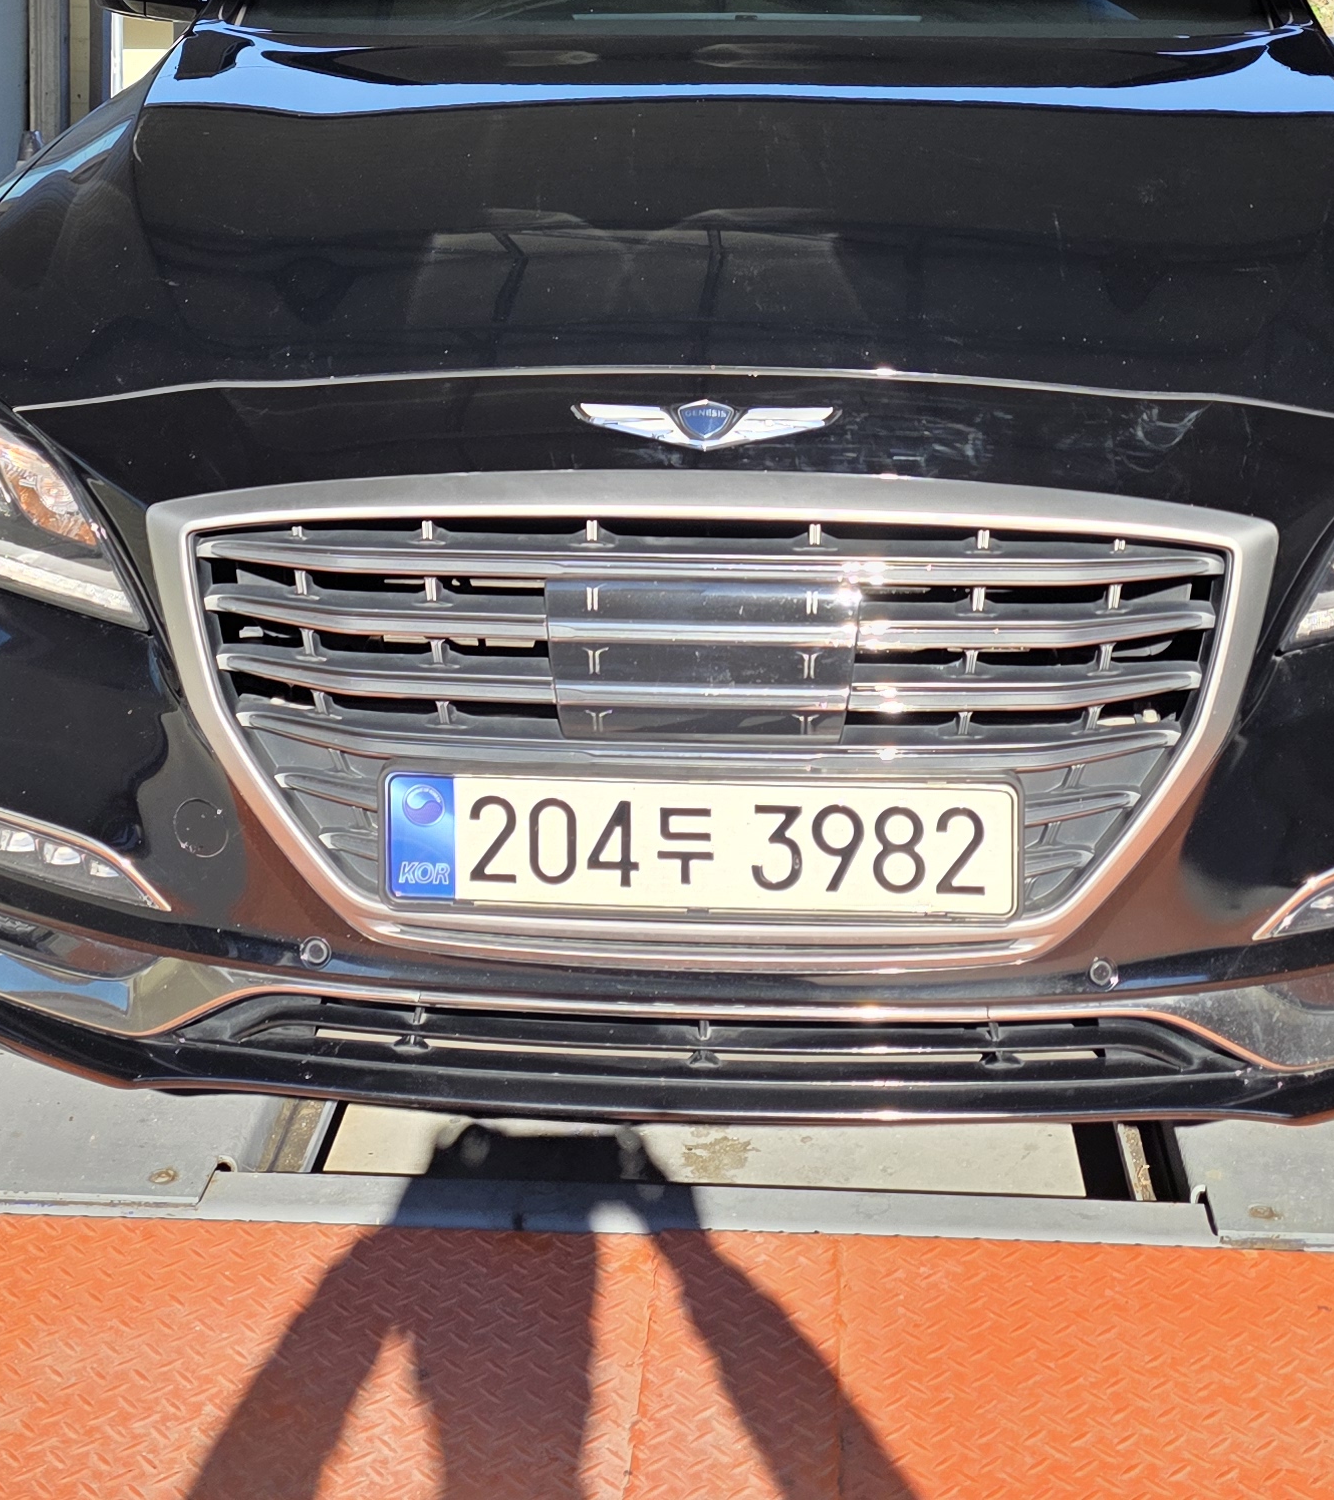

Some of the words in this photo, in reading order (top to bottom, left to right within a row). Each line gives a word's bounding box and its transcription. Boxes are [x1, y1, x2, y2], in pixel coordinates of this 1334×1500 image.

[685, 409, 727, 418] GENESIS
[468, 795, 716, 889] 204두
[751, 804, 986, 896] 3982
[398, 861, 450, 885] KOR
